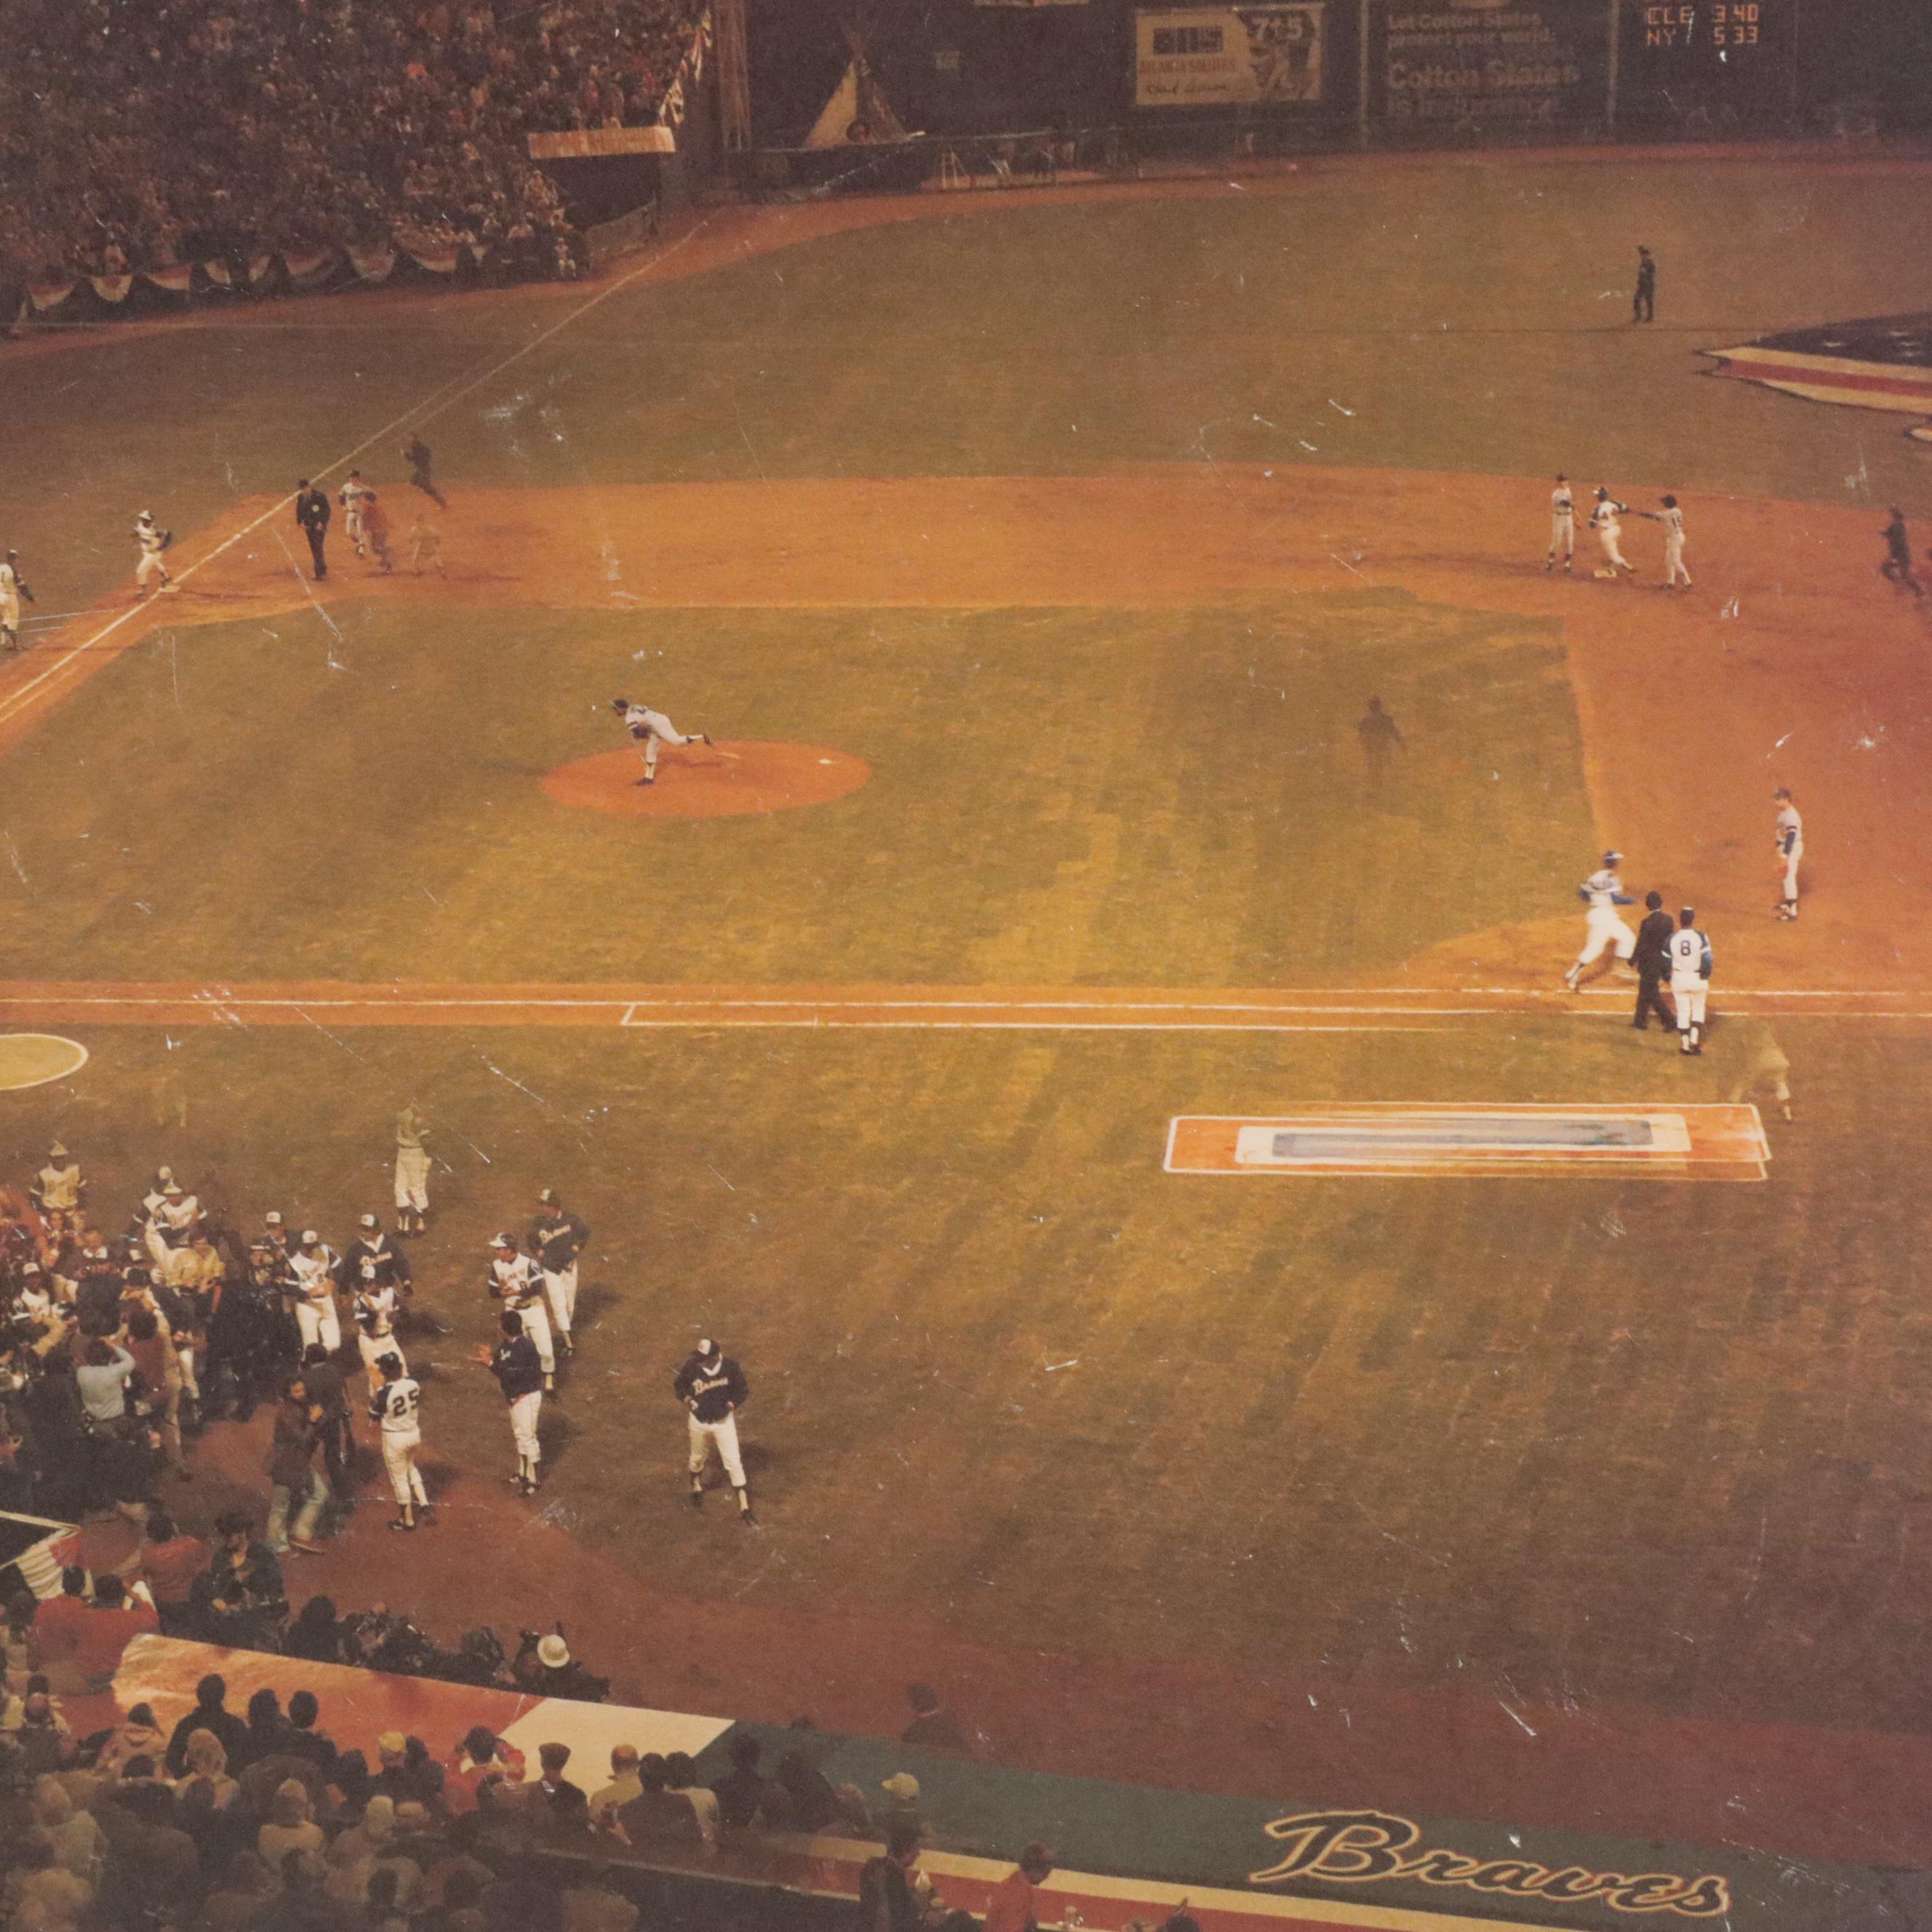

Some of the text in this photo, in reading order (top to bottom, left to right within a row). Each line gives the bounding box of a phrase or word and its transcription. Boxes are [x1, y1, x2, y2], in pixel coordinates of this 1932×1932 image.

[1647, 4, 1759, 25] CLE 3 40
[1252, 17, 1303, 39] 715
[1647, 28, 1677, 46] NY
[1733, 26, 1758, 44] 33
[1388, 62, 1480, 89] Cotton
[1680, 940, 1691, 957] 8
[392, 1387, 420, 1417] 25
[1248, 1810, 1730, 1917] Braves
